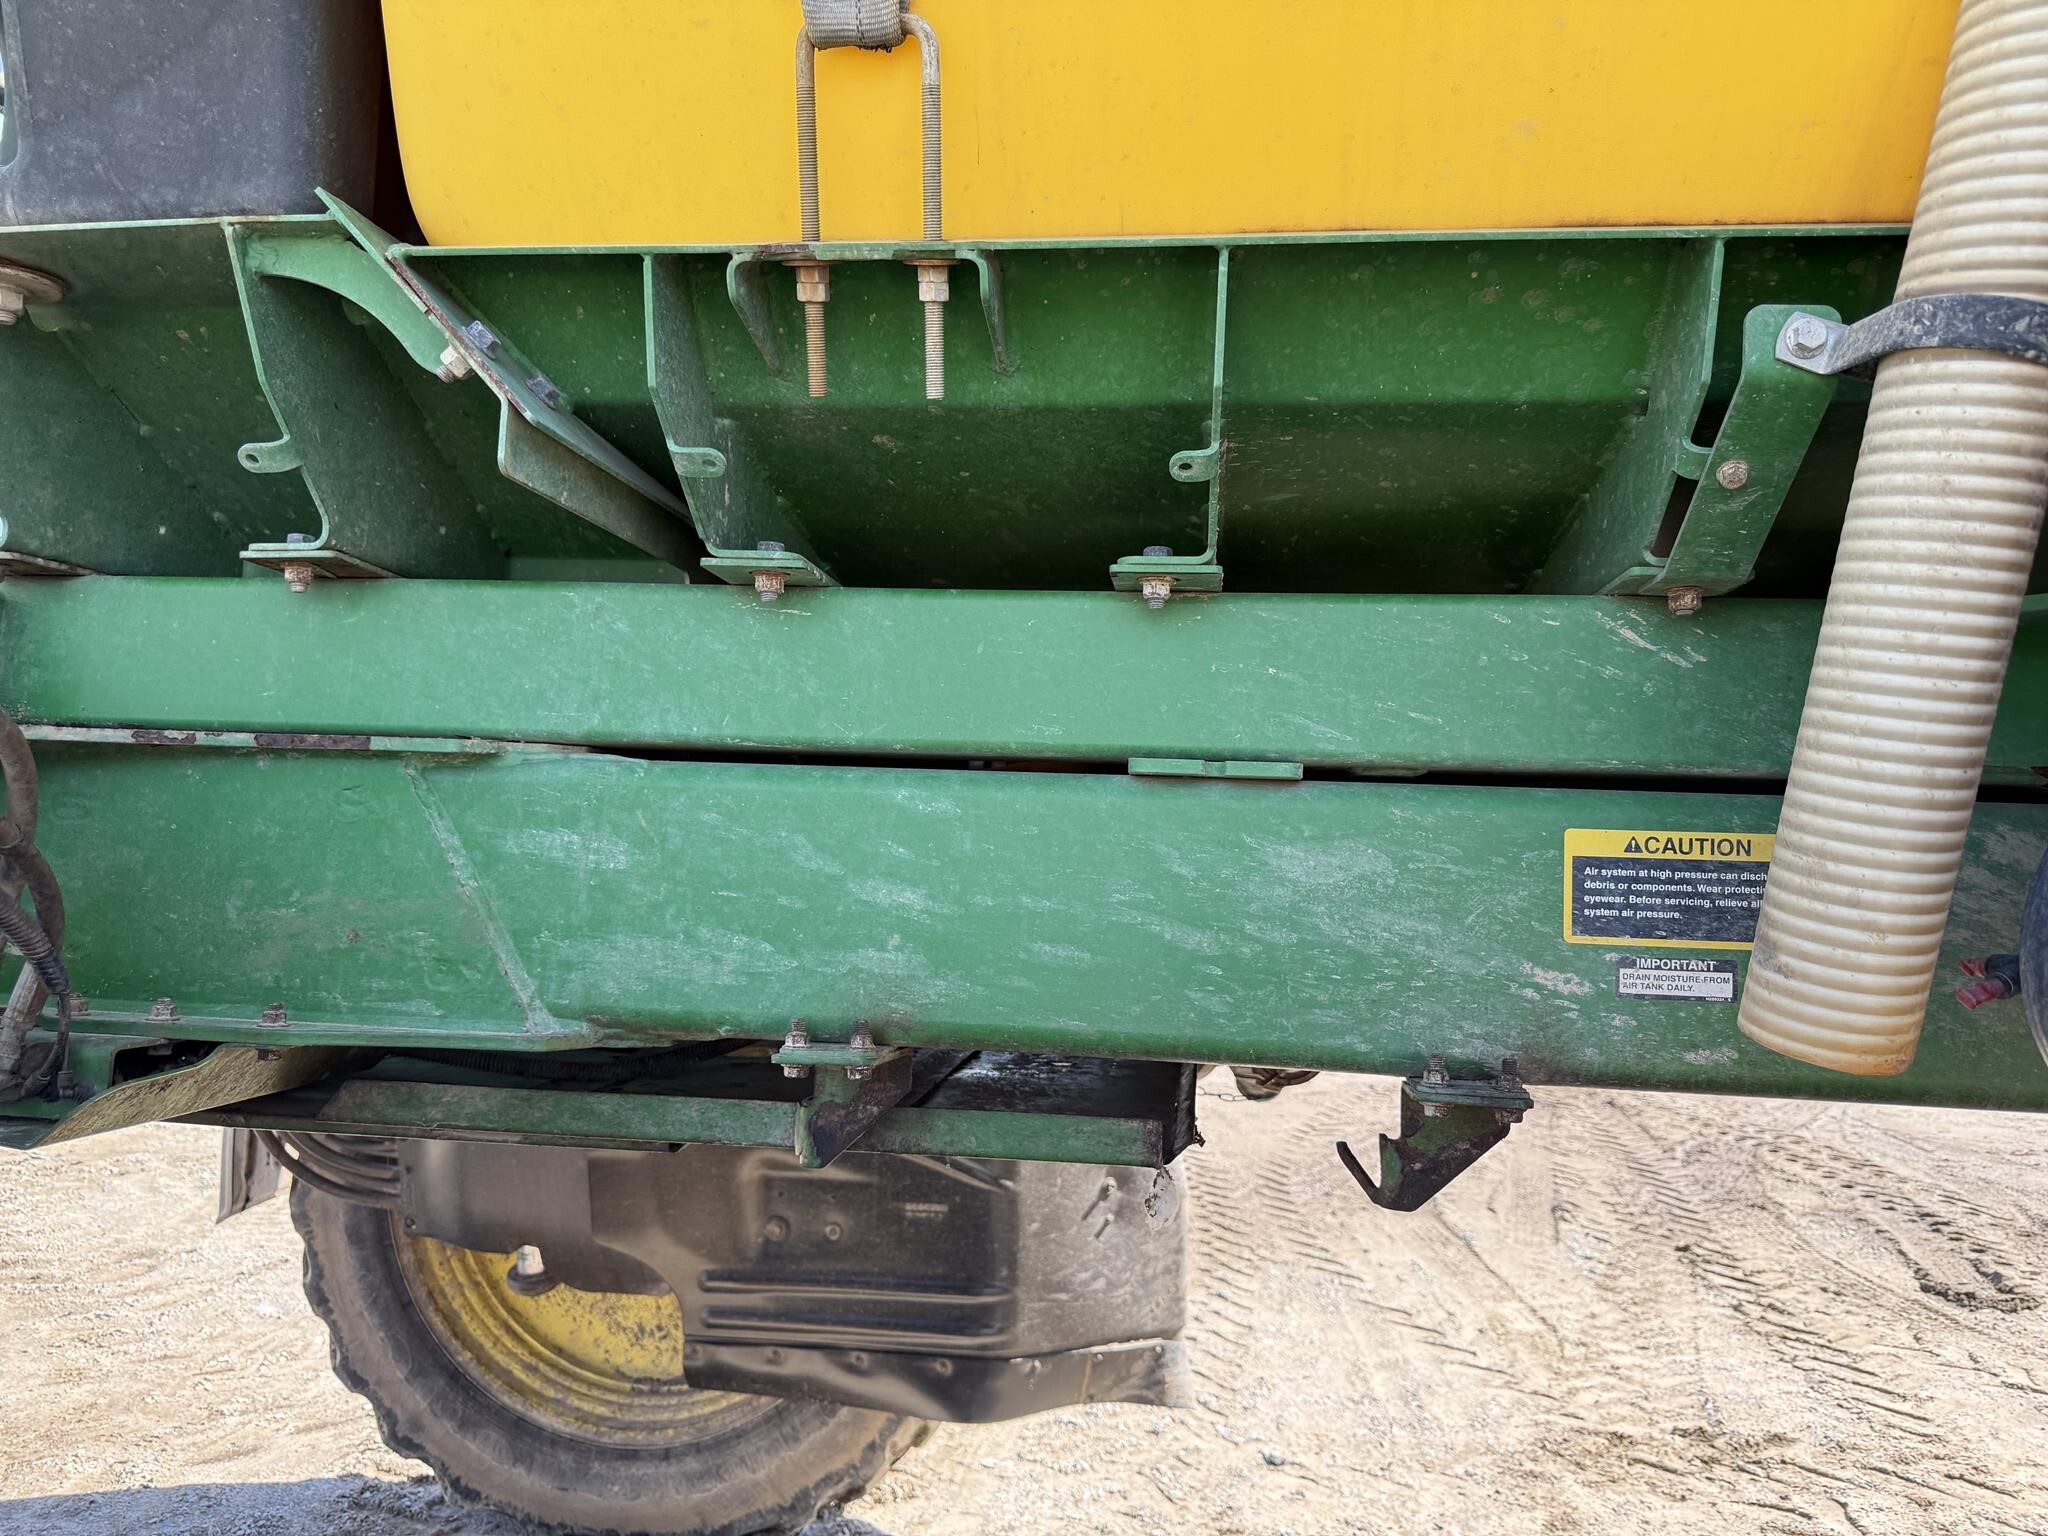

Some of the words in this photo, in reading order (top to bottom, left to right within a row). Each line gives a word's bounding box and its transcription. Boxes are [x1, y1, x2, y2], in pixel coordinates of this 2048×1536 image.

[1644, 836, 1752, 857] CAUTION
[1584, 866, 1599, 875] Air
[1601, 868, 1636, 878] system
[1638, 869, 1648, 877] at
[1650, 869, 1672, 880] high
[1674, 871, 1718, 880] pressure
[1720, 872, 1738, 880] can
[1584, 880, 1616, 890] debris
[1631, 883, 1695, 893] components.
[1697, 884, 1722, 893] Wear
[1725, 885, 1765, 895] protecti
[1584, 895, 1627, 904] eyewear.
[1629, 895, 1662, 905] Before
[1664, 897, 1713, 908] servicing,
[1715, 899, 1748, 908] relieve
[1584, 908, 1619, 918] system
[1621, 909, 1635, 917] air
[1637, 910, 1683, 920] pressure.
[1636, 957, 1717, 972] IMPORTANT
[1622, 972, 1651, 981] DRAIN
[1622, 982, 1638, 990] AIR
[1640, 983, 1664, 991] TANK
[1667, 984, 1695, 992] DAILY.
